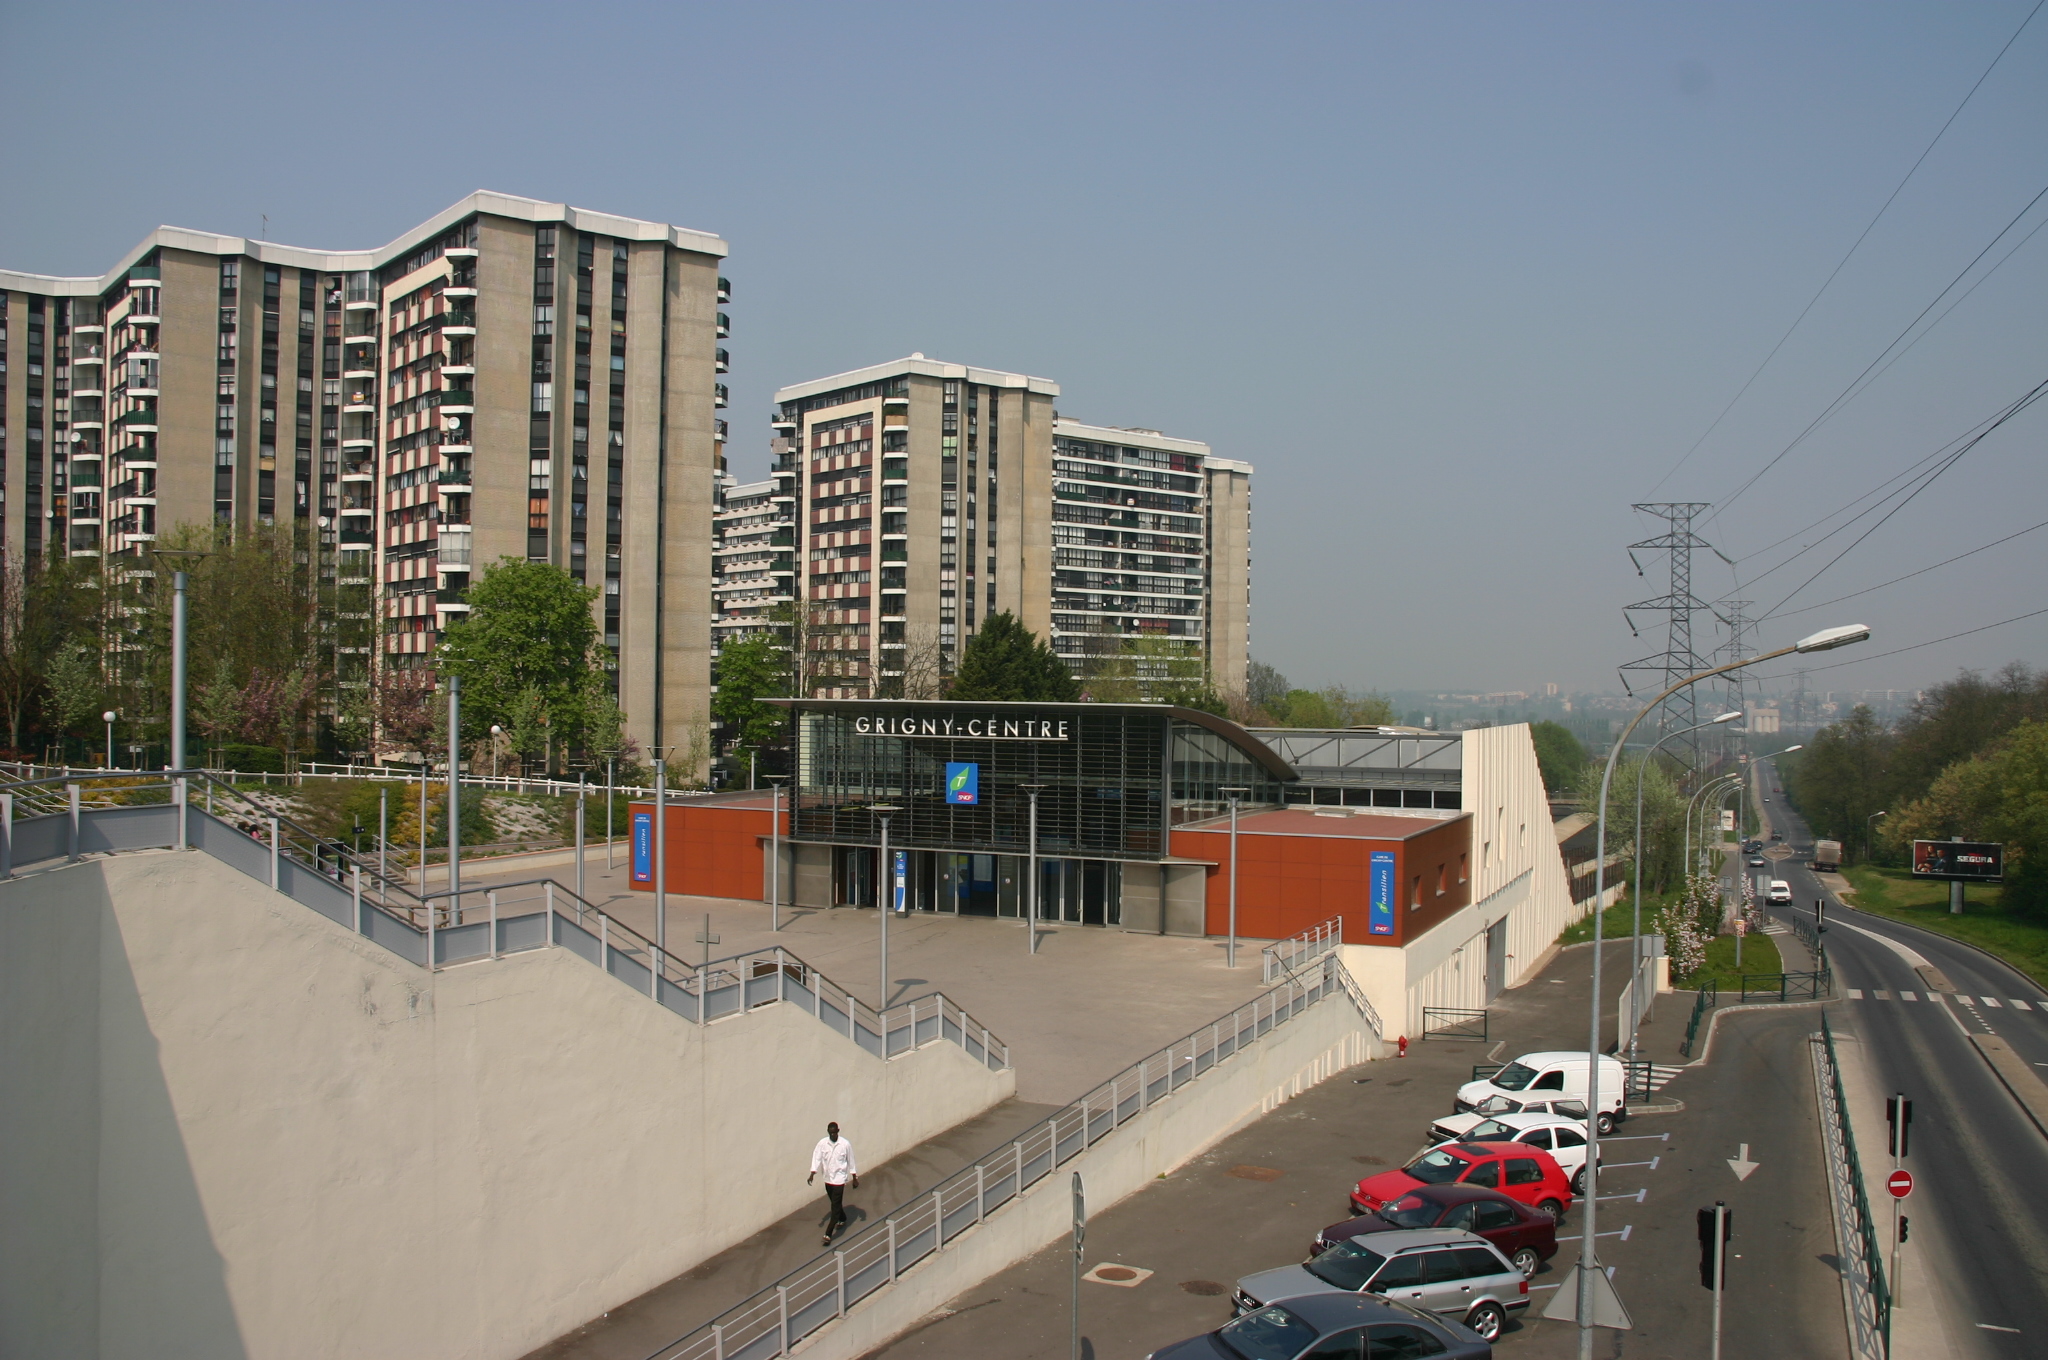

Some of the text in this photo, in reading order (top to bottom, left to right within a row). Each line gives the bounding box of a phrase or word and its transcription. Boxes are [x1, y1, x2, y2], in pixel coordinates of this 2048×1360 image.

[855, 716, 1068, 738] GRIGNY-CENTRE
[957, 776, 966, 787] T
[1956, 855, 1993, 863] SEGURA
